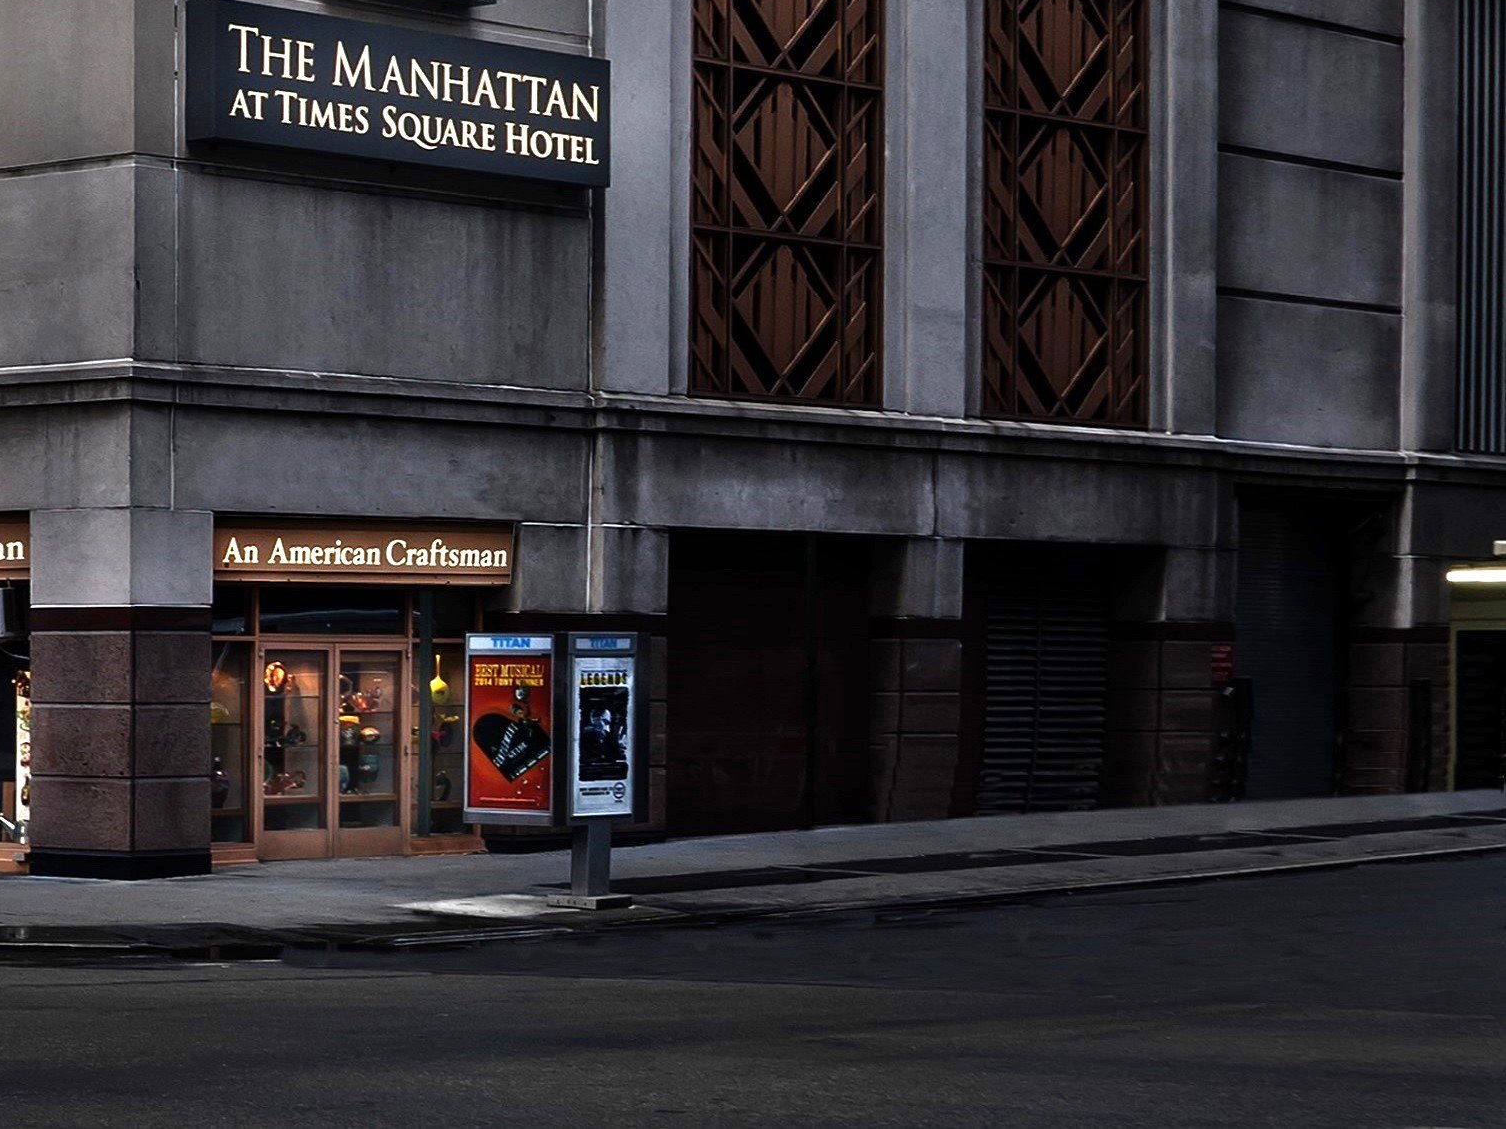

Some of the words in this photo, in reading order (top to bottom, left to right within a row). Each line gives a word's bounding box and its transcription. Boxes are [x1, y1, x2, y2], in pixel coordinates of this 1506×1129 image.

[228, 23, 316, 83] THE
[332, 40, 600, 123] MANHATTAN
[229, 88, 269, 121] AT
[274, 89, 369, 135] TIMES
[381, 105, 496, 152] SQUARE
[505, 122, 600, 165] HOTEL
[222, 537, 259, 564] An
[267, 537, 381, 566] American
[385, 538, 508, 568] Craftsman
[491, 637, 531, 648] TITAN
[475, 664, 499, 677] BEST
[475, 678, 492, 686] 2014
[581, 673, 627, 685] LEGENDS
